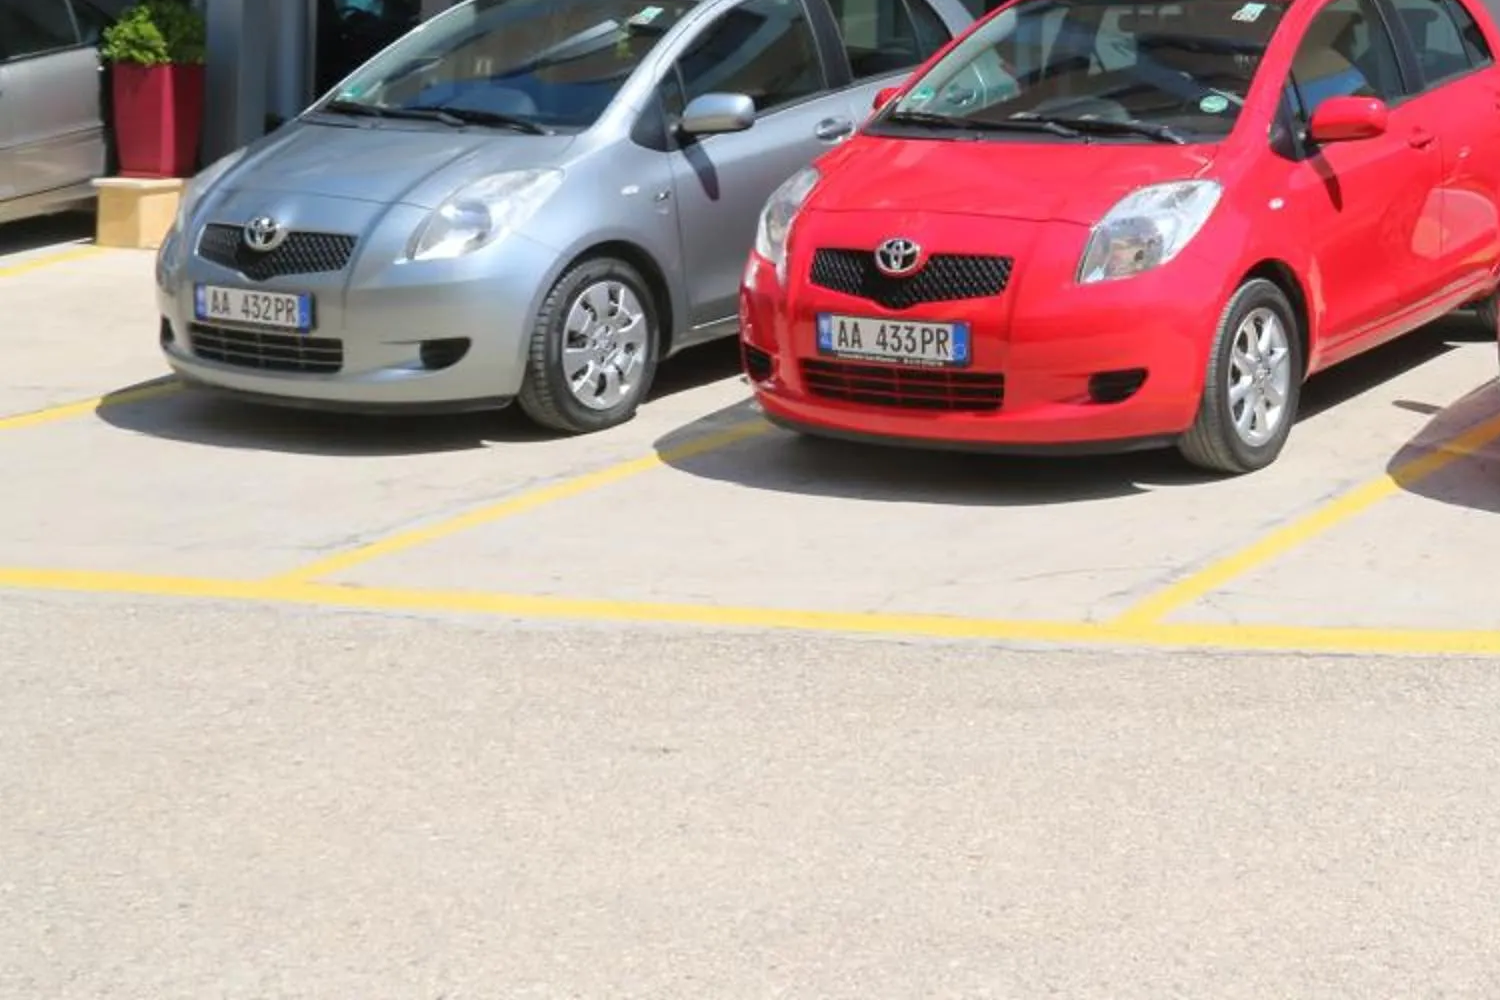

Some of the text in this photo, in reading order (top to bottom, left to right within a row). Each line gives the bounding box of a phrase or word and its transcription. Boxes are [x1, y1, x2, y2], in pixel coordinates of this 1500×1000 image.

[211, 289, 231, 315] AA
[241, 293, 296, 325] 432PR
[837, 320, 950, 356] AA 433PR
